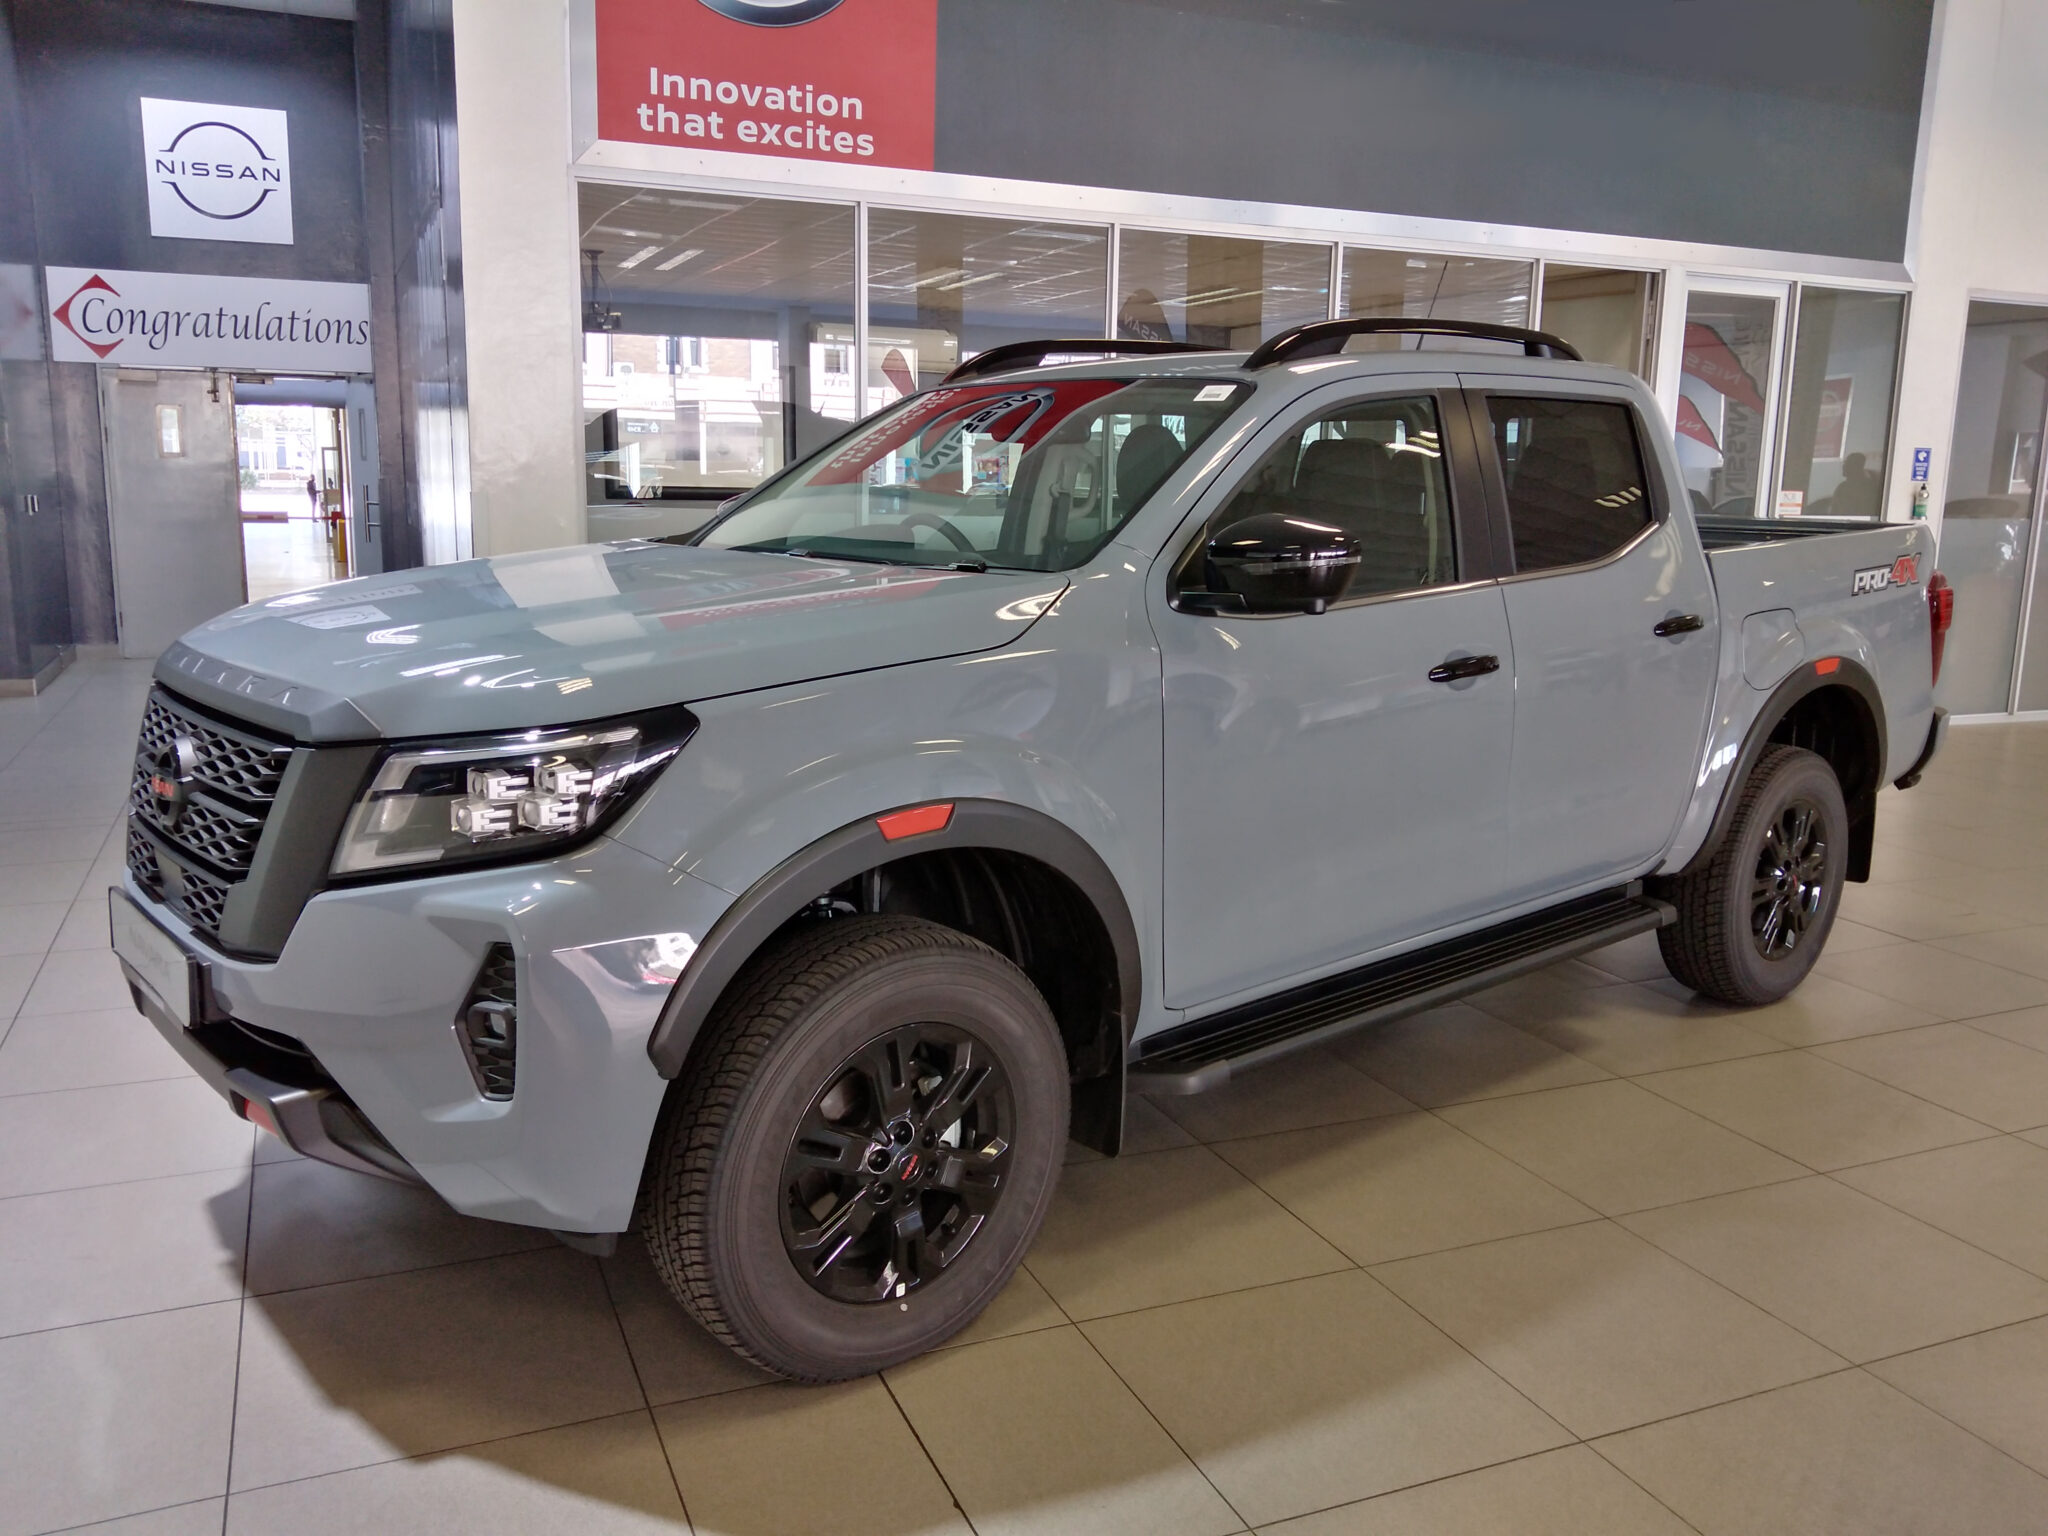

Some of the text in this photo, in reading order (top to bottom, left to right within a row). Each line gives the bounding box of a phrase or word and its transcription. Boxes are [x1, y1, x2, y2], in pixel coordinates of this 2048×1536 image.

[650, 67, 862, 120] Innovation
[637, 103, 874, 156] that excites
[156, 159, 280, 182] NISSAN
[82, 298, 368, 350] Congratulations
